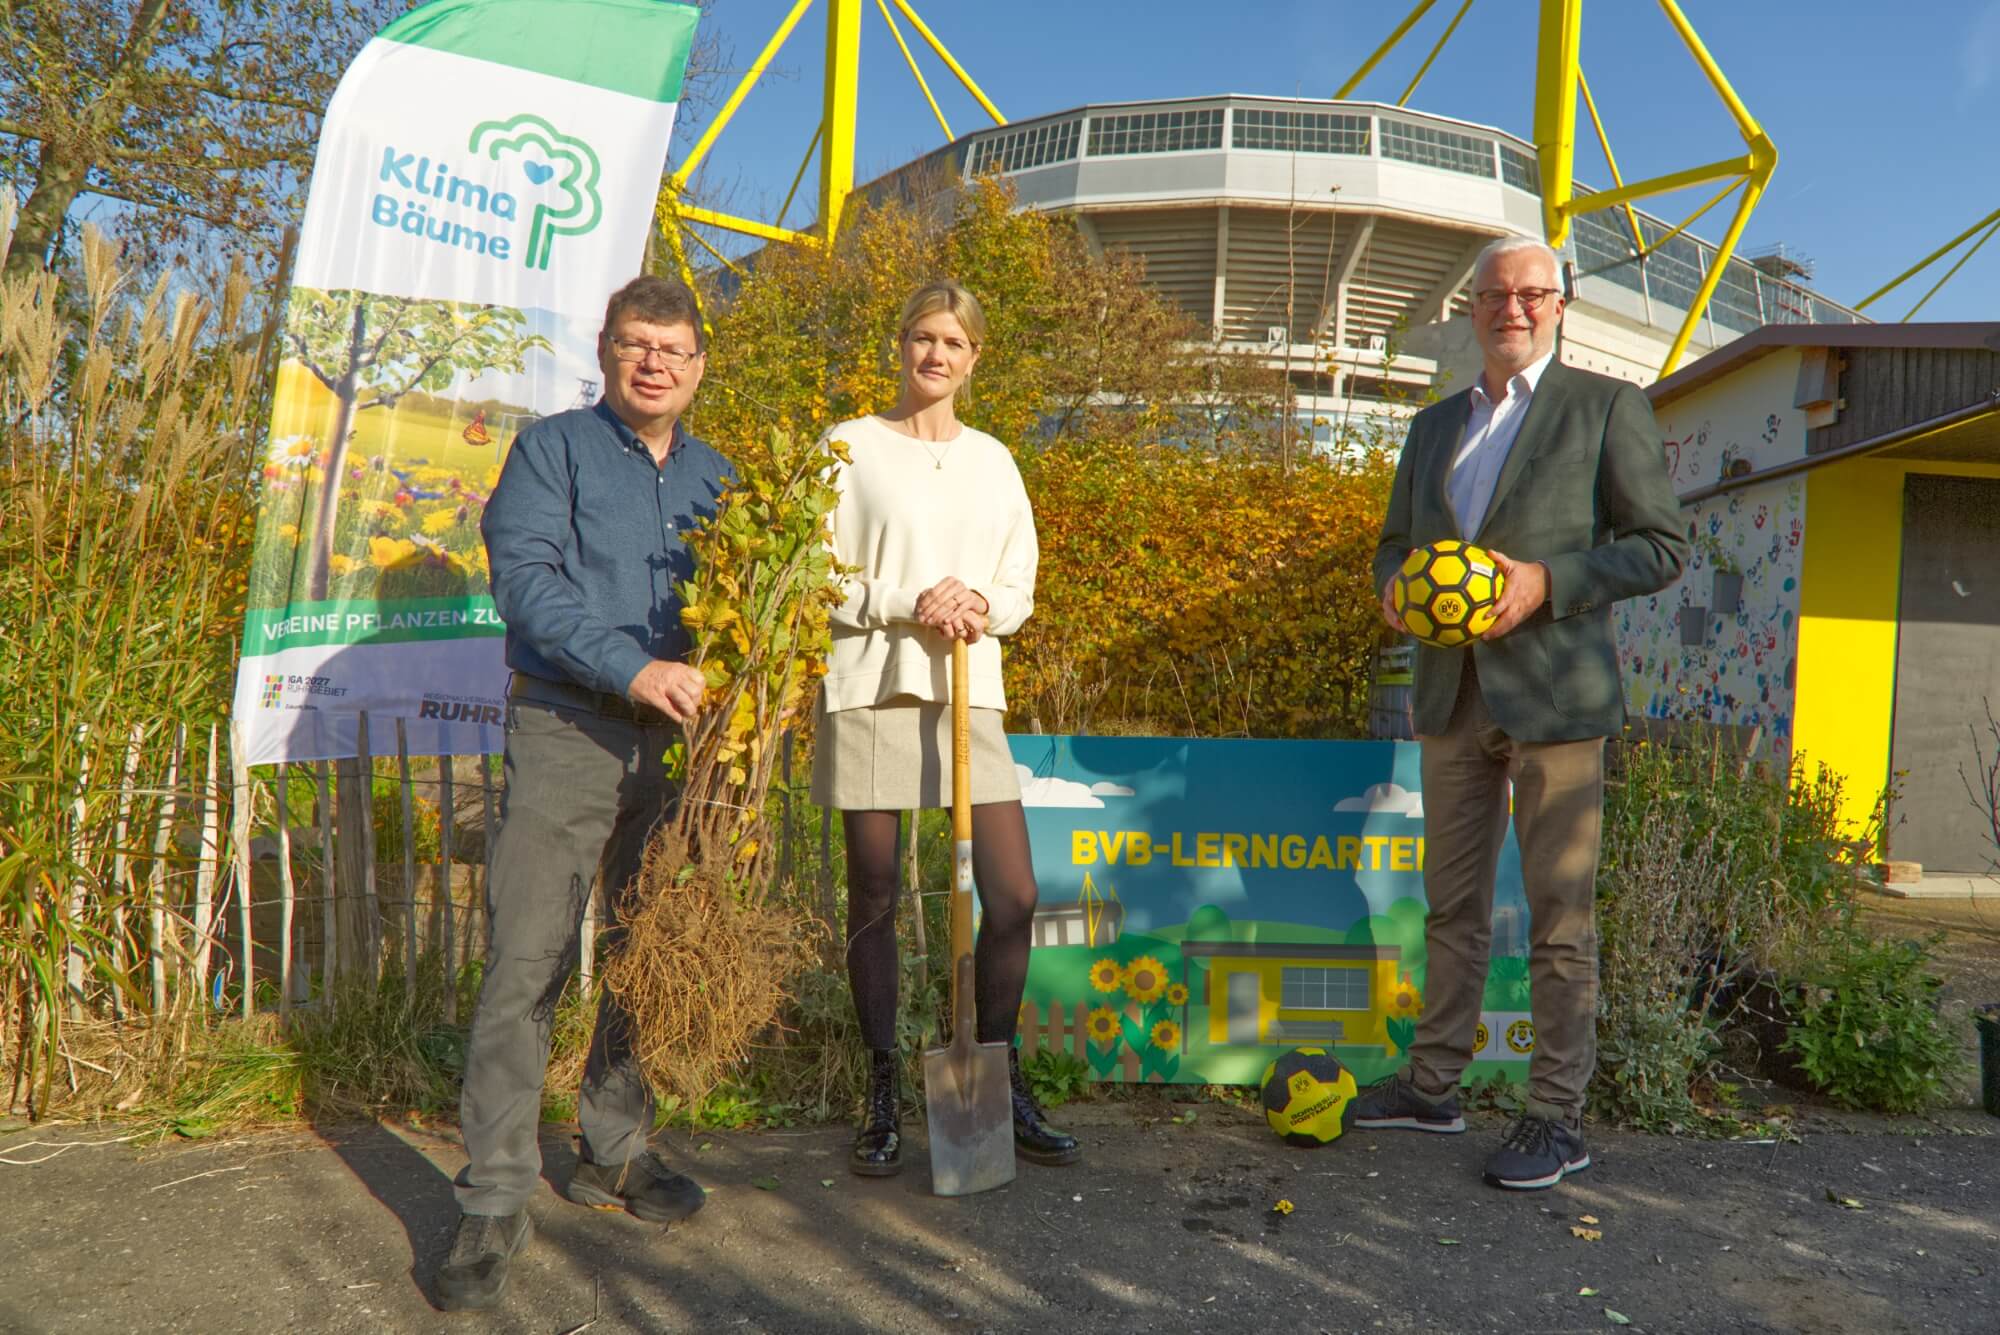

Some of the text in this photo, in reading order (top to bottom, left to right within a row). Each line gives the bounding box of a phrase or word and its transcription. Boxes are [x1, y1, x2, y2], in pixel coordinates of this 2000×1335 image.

[379, 146, 517, 222] Klima
[372, 193, 511, 260] Bäume
[264, 613, 339, 640] VEREINE
[346, 609, 467, 631] PFLANZEN
[288, 675, 331, 686] IGA 2027
[419, 700, 502, 727] RUHR
